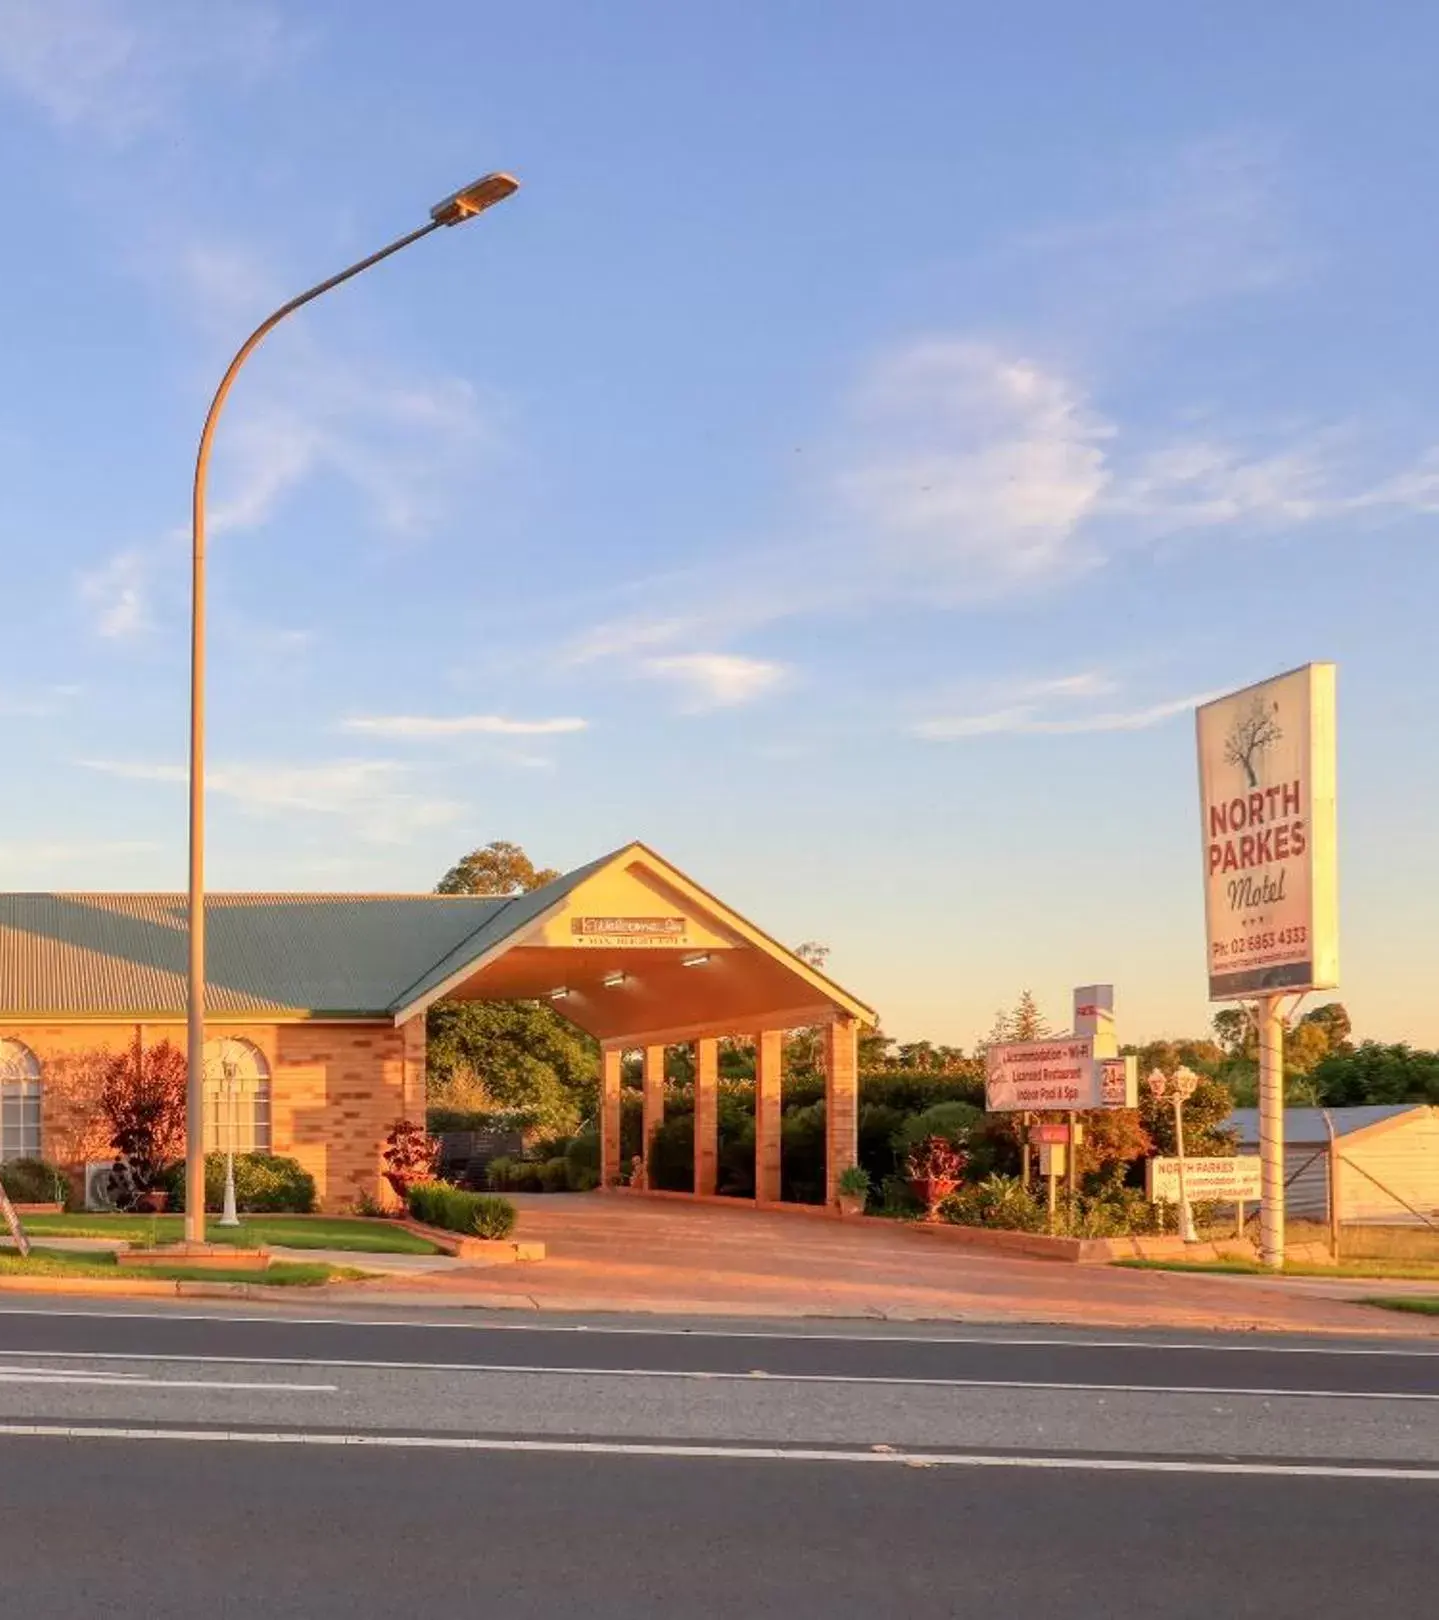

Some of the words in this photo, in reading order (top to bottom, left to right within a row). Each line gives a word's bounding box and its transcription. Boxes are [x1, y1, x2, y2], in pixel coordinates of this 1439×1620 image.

[1210, 781, 1300, 838] NORTH
[1209, 821, 1306, 876] PARKES
[1227, 867, 1286, 911] Motel
